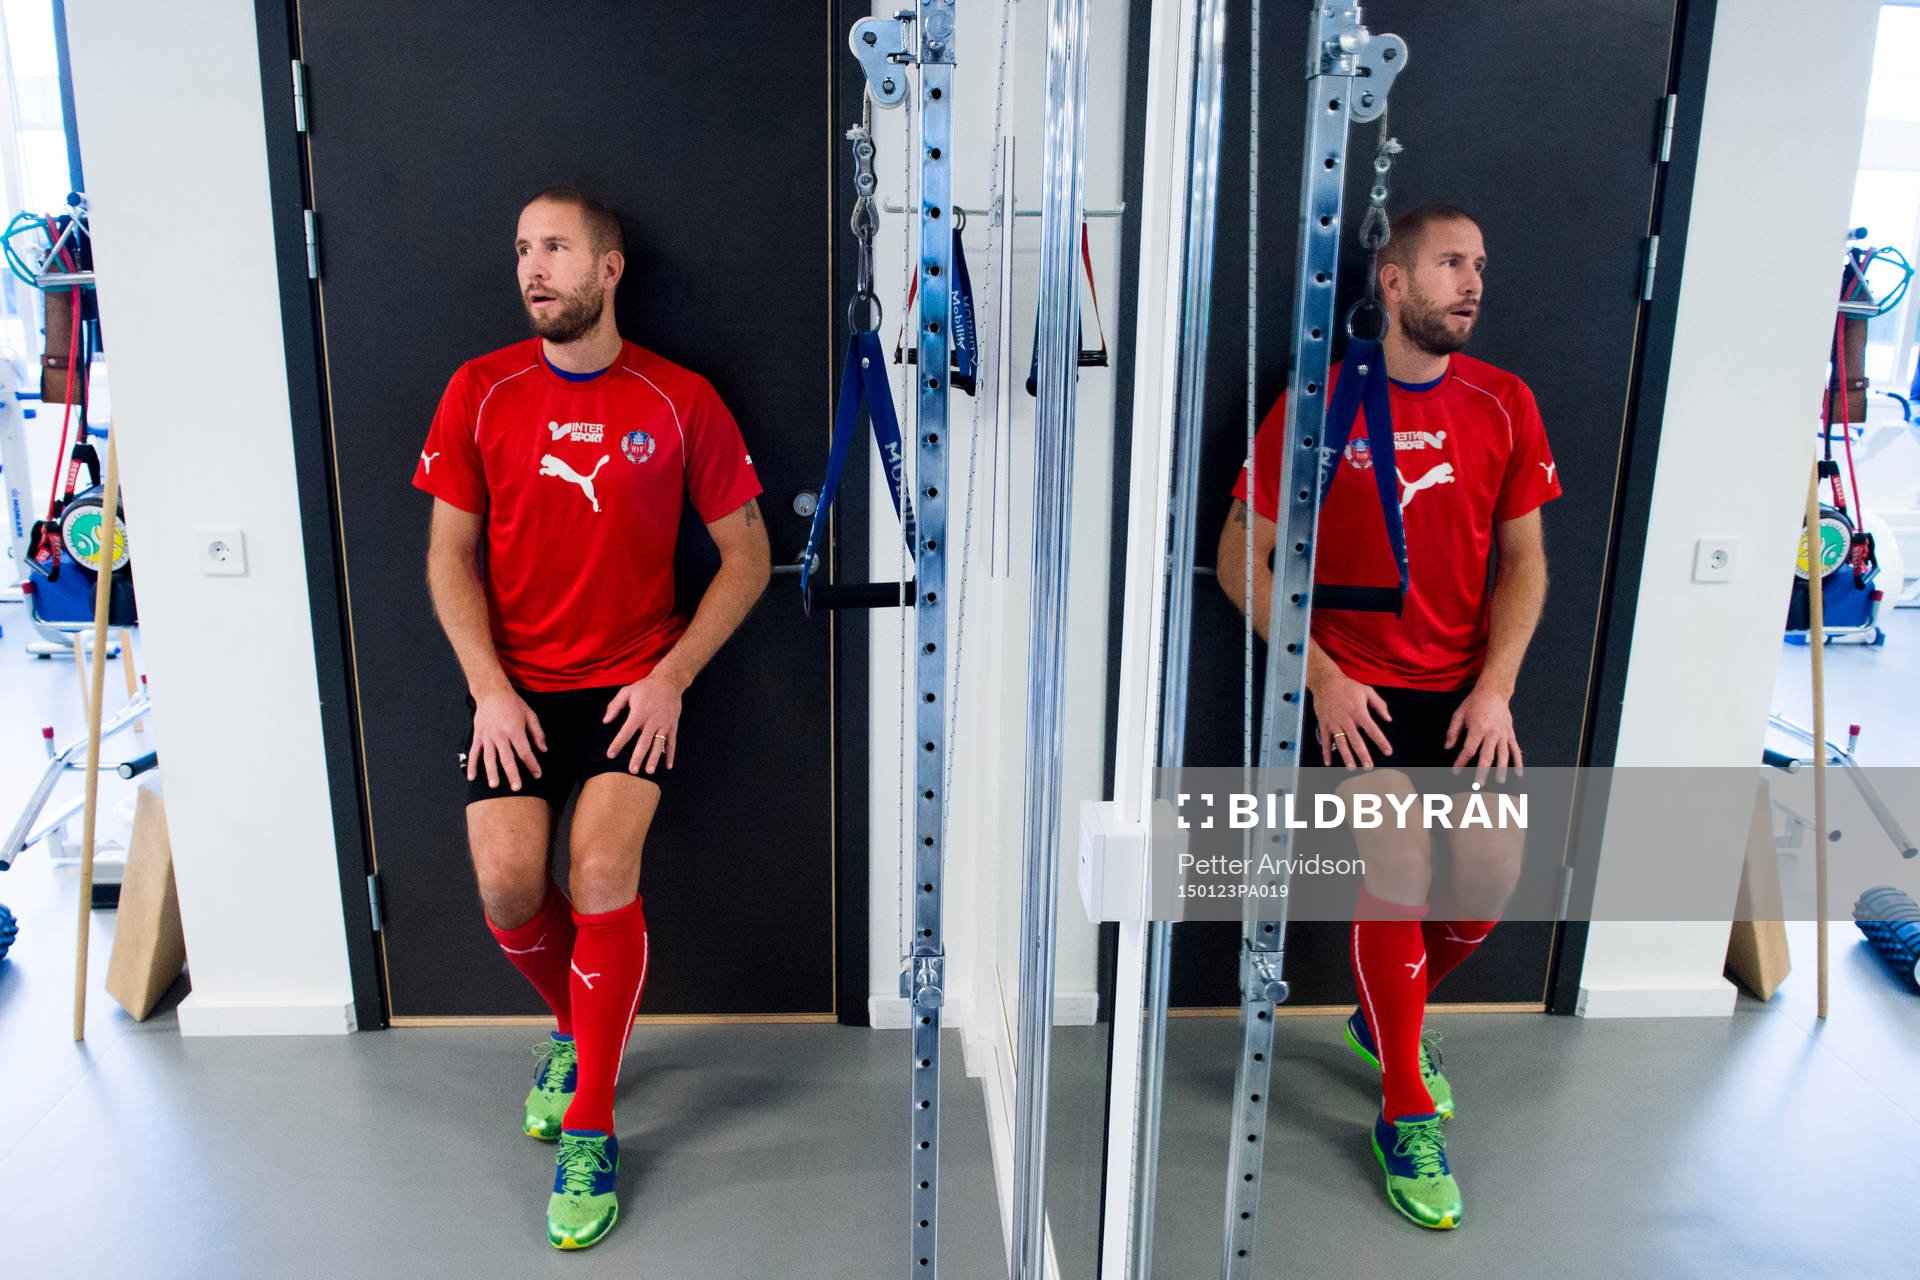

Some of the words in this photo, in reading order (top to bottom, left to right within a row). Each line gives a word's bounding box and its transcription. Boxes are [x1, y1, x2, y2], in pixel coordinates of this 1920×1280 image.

[952, 290, 966, 351] Mobility
[571, 422, 604, 433] INTER
[571, 432, 604, 443] SPORT
[631, 445, 644, 454] HIF
